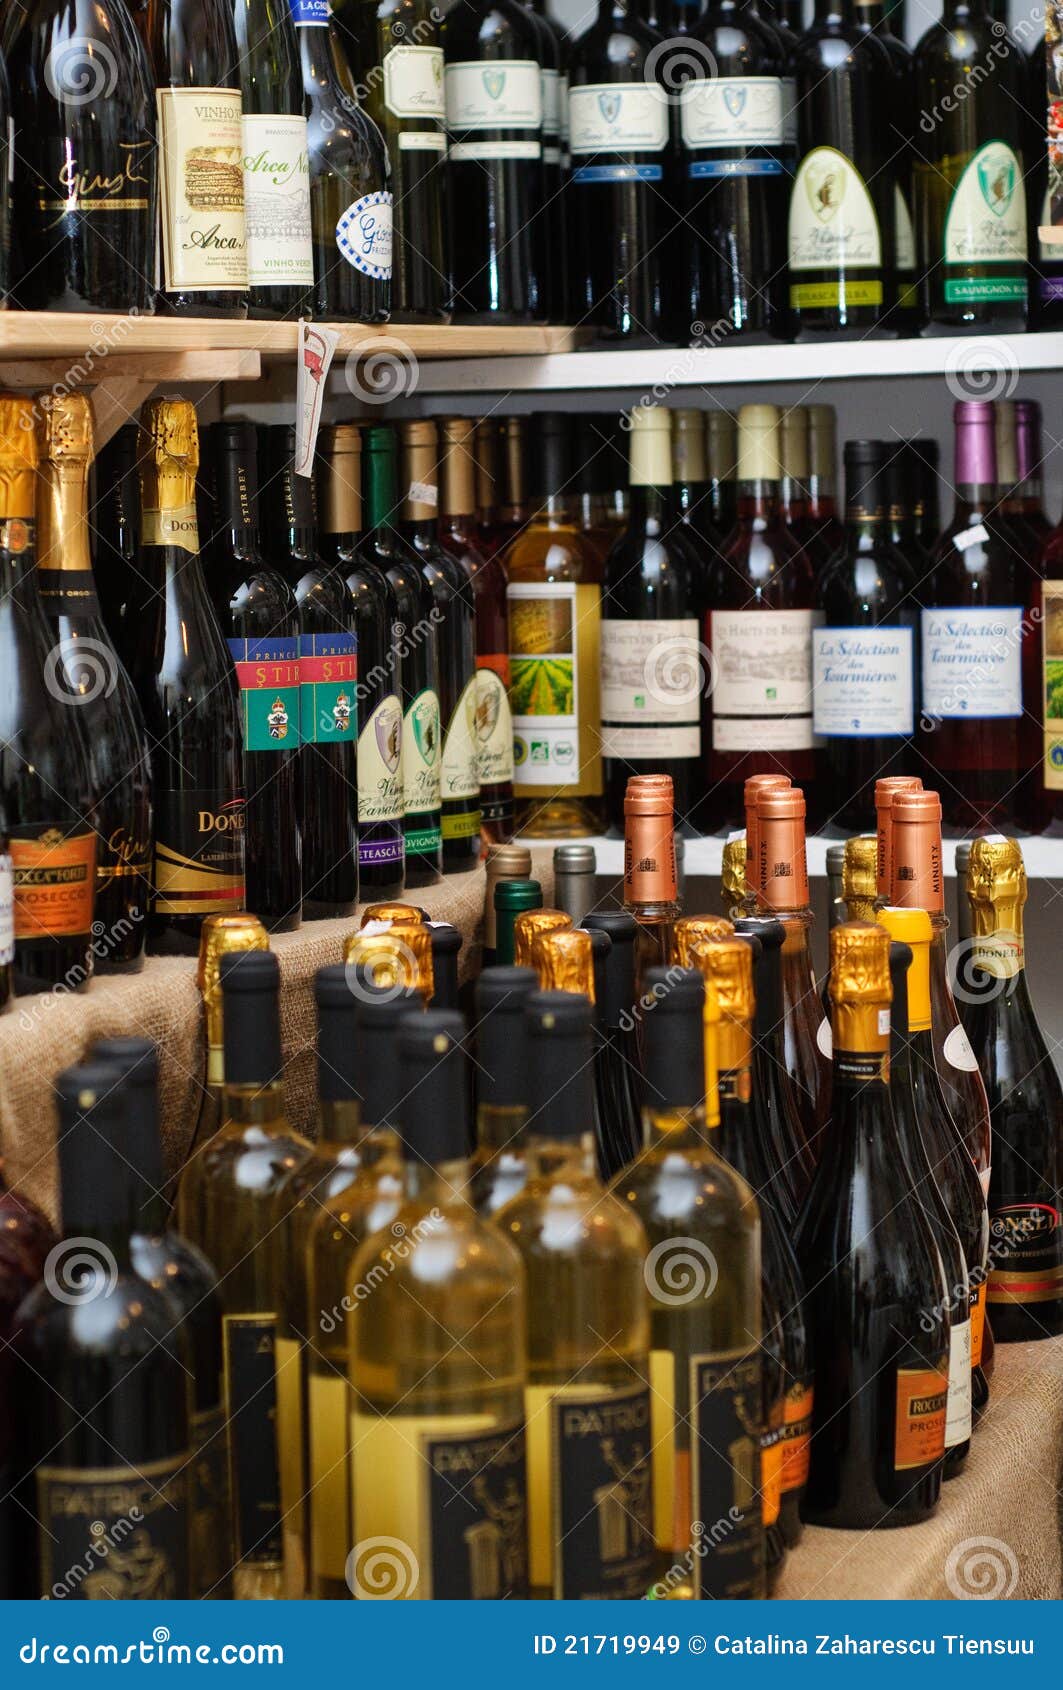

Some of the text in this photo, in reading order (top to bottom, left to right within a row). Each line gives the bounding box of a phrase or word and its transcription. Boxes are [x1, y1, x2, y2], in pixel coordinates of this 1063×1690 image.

[243, 150, 288, 172] Arca
[182, 224, 237, 249] Arca
[760, 840, 768, 891] MINUTY
[931, 845, 941, 893] MINUTY
